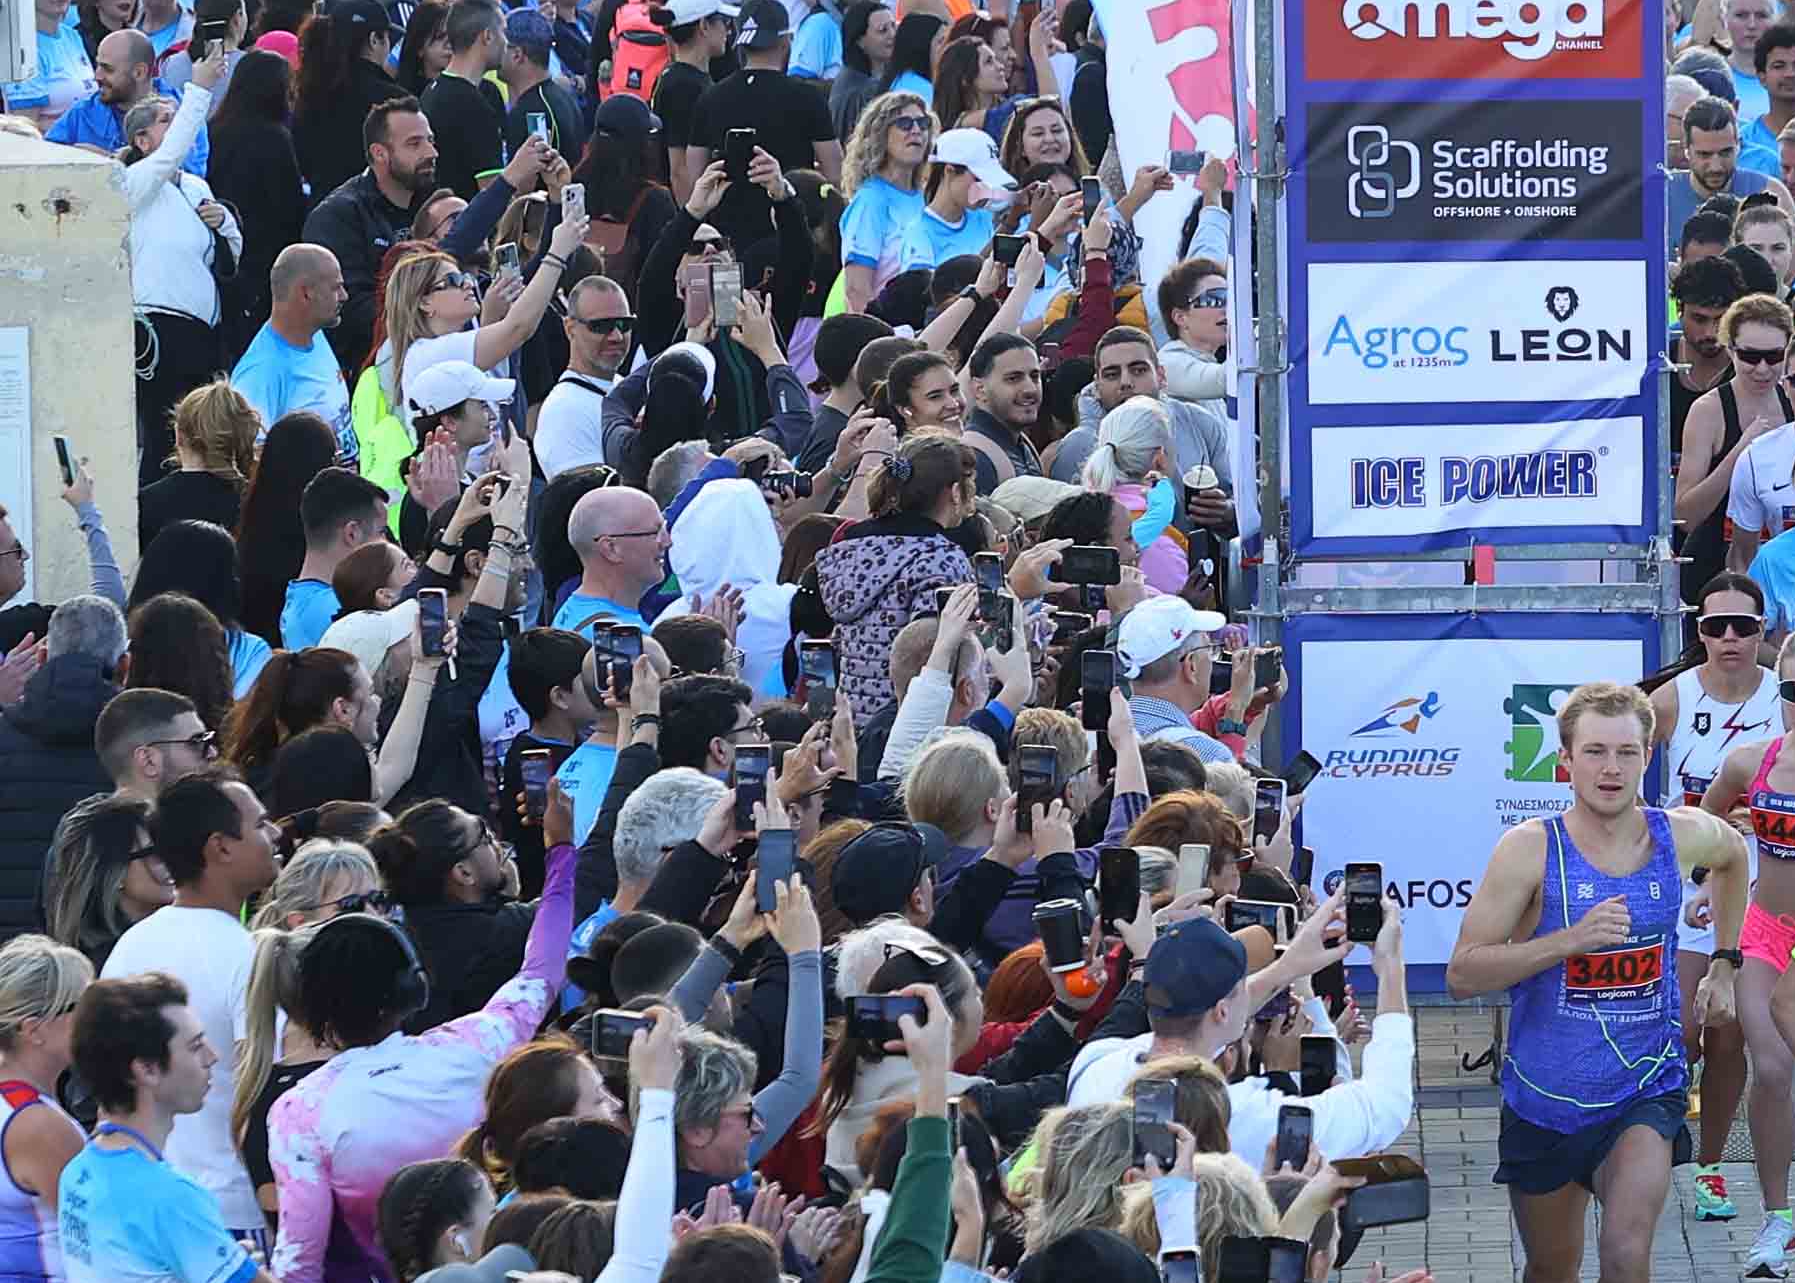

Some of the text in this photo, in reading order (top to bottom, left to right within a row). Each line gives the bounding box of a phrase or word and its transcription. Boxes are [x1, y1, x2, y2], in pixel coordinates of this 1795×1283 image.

[1555, 39, 1603, 51] CHANNEL
[1432, 139, 1609, 175] Scaffolding
[1432, 170, 1577, 200] Solutions
[1433, 205, 1577, 218] OFFSHORE ONSHORE
[1491, 328, 1632, 363] LEON
[1392, 356, 1452, 368] at 1235m
[1351, 448, 1598, 510] ICE POWER
[1324, 747, 1462, 765] RUNNING
[1331, 763, 1457, 778] CYPRUS
[1384, 878, 1474, 910] AFOS
[1572, 951, 1657, 985] 3402
[1596, 989, 1636, 1001] Logicom
